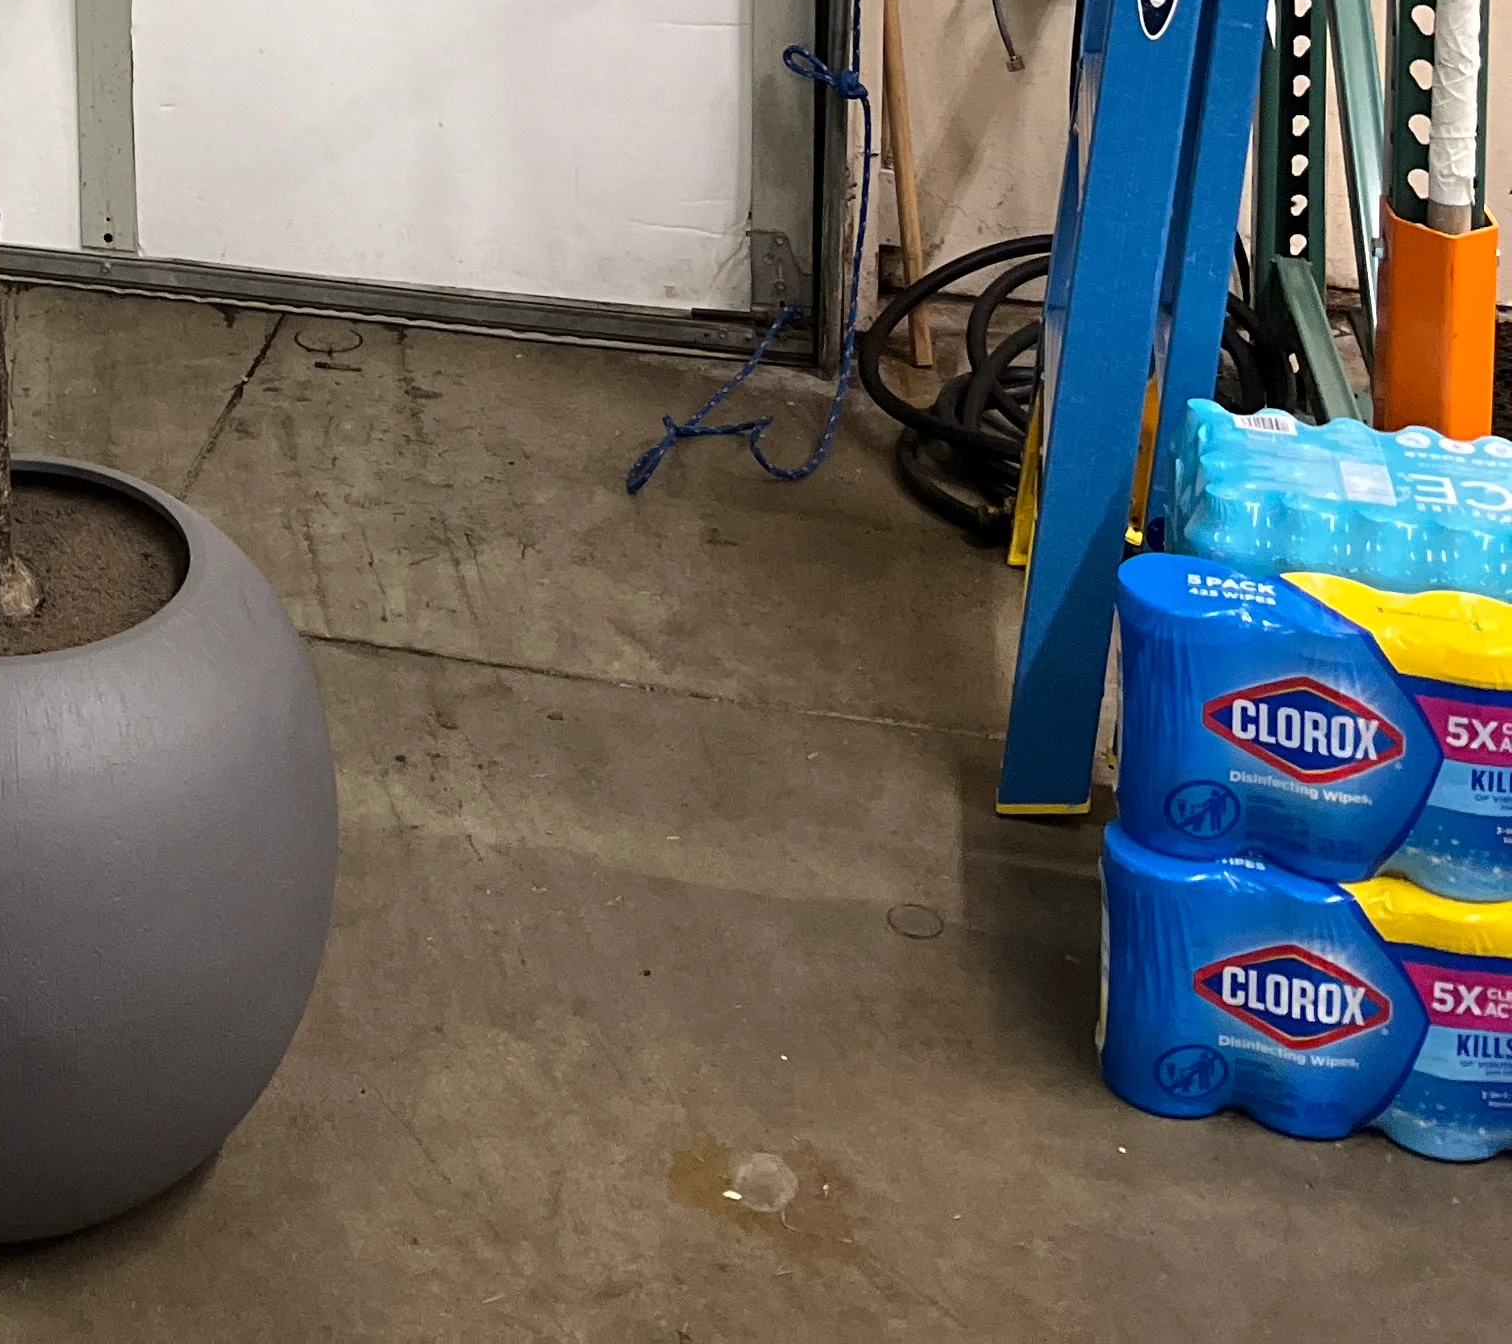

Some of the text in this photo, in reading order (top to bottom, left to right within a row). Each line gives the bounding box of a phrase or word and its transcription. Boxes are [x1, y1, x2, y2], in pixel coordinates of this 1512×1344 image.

[1206, 576, 1275, 595] PACK
[1221, 590, 1276, 605] WIPES
[1231, 698, 1379, 761] CLOROX
[1445, 715, 1497, 752] 5X
[1229, 770, 1319, 800] Disinfecting
[1471, 768, 1512, 793] KIL
[1221, 966, 1366, 1026] CLOROX
[1432, 981, 1483, 1015] 5X
[1484, 1002, 1512, 1019] AC
[1218, 1034, 1307, 1066] Disinfecting
